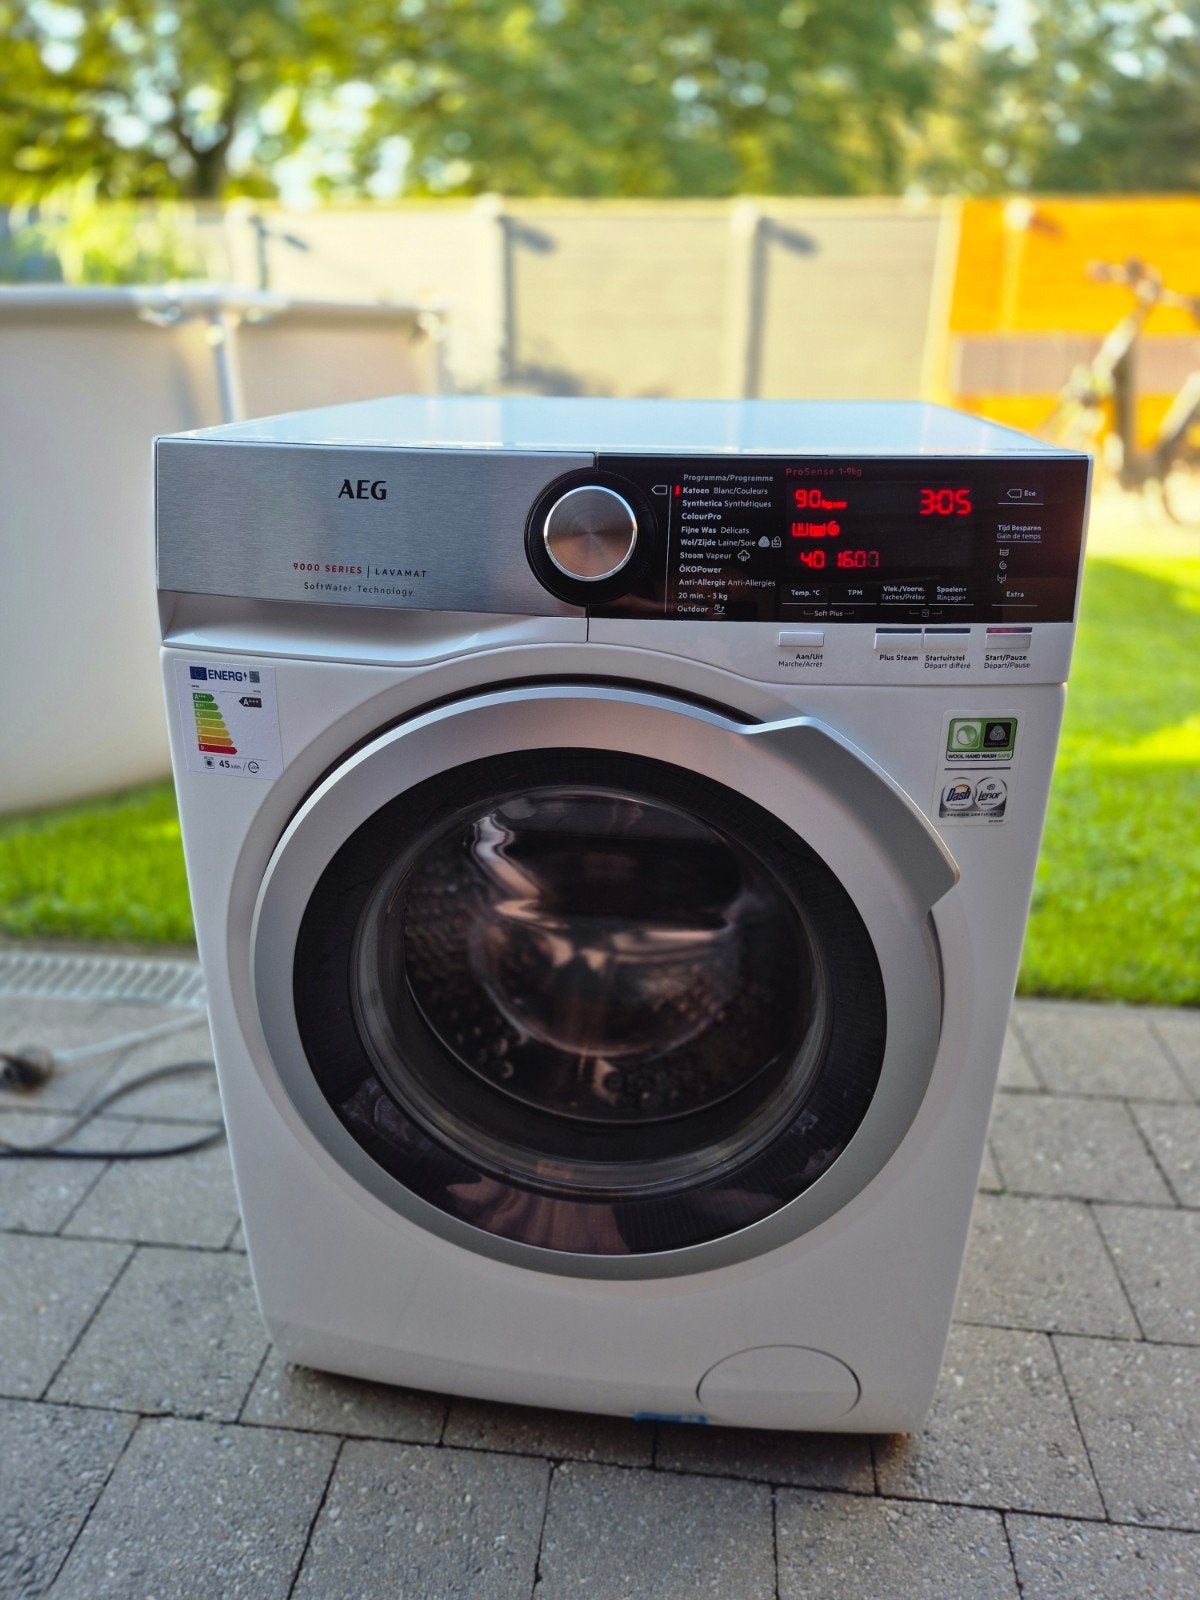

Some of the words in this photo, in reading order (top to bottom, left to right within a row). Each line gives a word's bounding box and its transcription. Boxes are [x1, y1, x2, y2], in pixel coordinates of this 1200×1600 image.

[684, 474, 774, 482] Programma/Programme
[786, 468, 834, 476] ProSense
[338, 479, 387, 500] AEG
[681, 539, 716, 547] Wol/Zijde
[800, 550, 825, 568] 40
[293, 562, 320, 572] 9000
[325, 565, 362, 574] SERIES
[375, 568, 427, 578] LAVAMAT
[680, 564, 722, 573] ÖKOPower
[304, 582, 352, 592] SoftWater
[358, 586, 413, 596] Technology
[208, 670, 242, 682] ENERG
[946, 788, 971, 802] Dash
[978, 791, 1002, 801] Lenor
